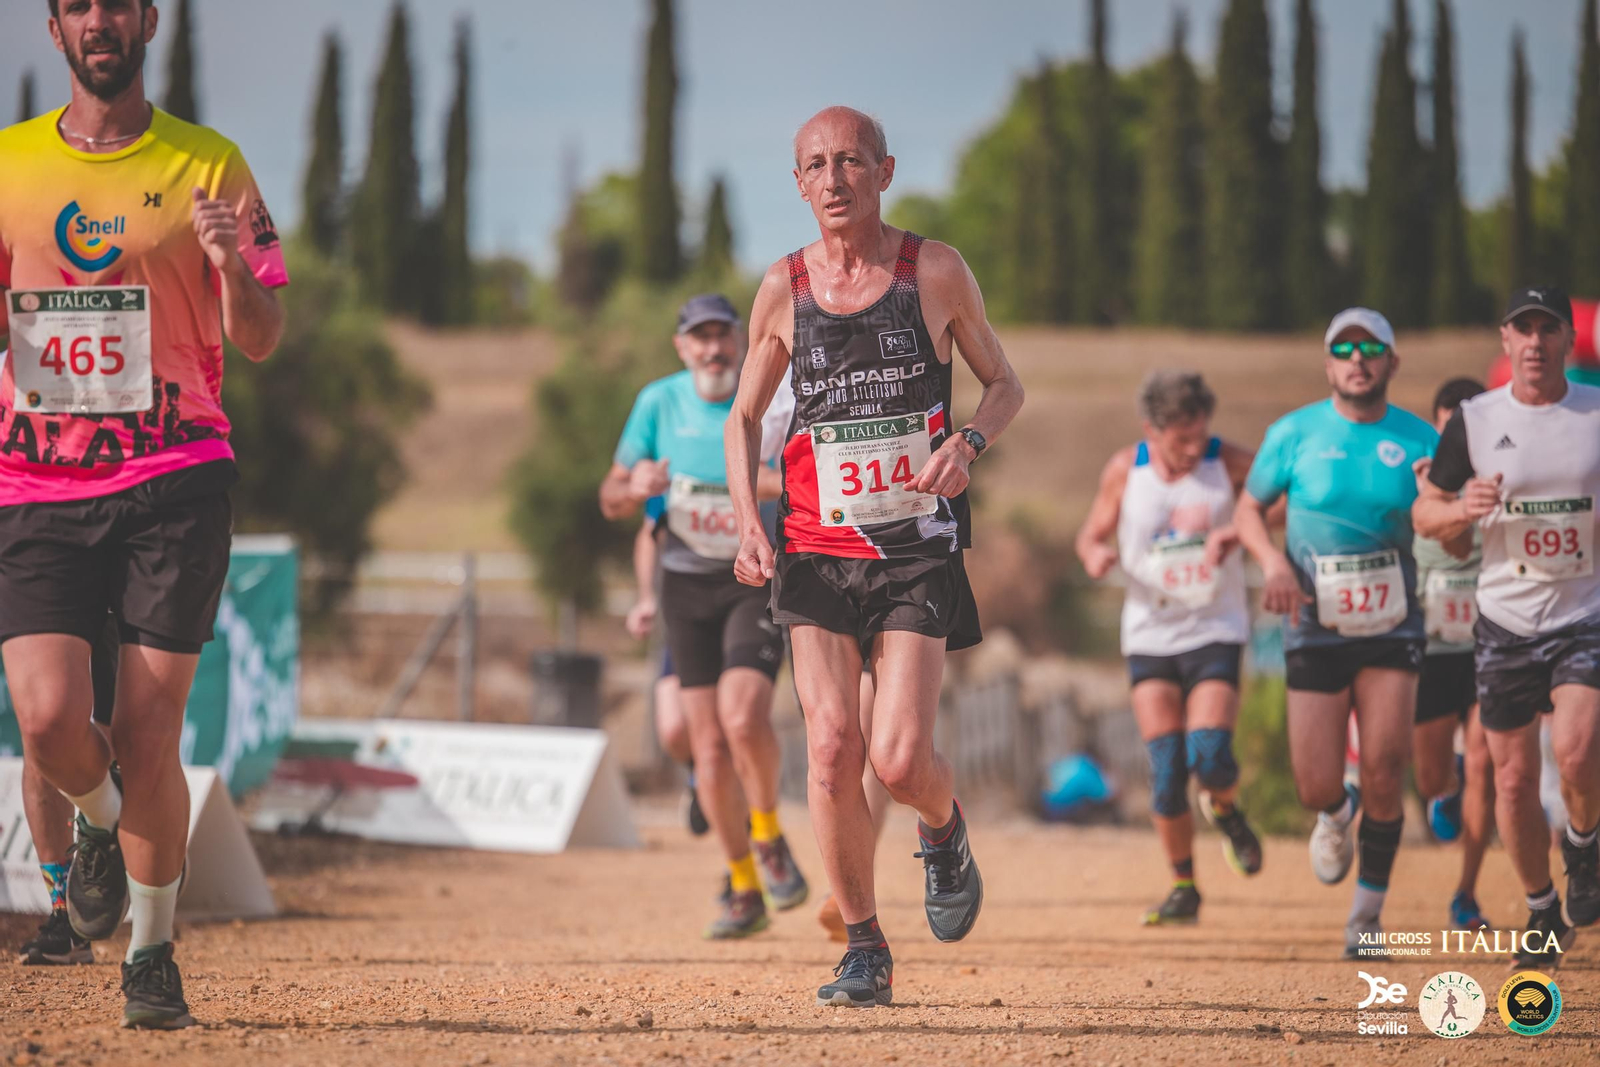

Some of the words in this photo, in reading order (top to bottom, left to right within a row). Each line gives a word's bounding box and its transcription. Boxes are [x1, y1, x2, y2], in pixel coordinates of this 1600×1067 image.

[75, 215, 126, 235] Snell
[39, 335, 125, 376] 465
[801, 373, 846, 396] SAN
[850, 362, 926, 386] PABLO
[826, 388, 848, 405] CLUB
[853, 381, 904, 401] ATLETISMO
[849, 403, 883, 417] SEVILLA
[843, 423, 898, 439] ITÁLICA
[839, 454, 914, 496] 314
[1524, 526, 1579, 557] 693
[1337, 583, 1390, 615] 327
